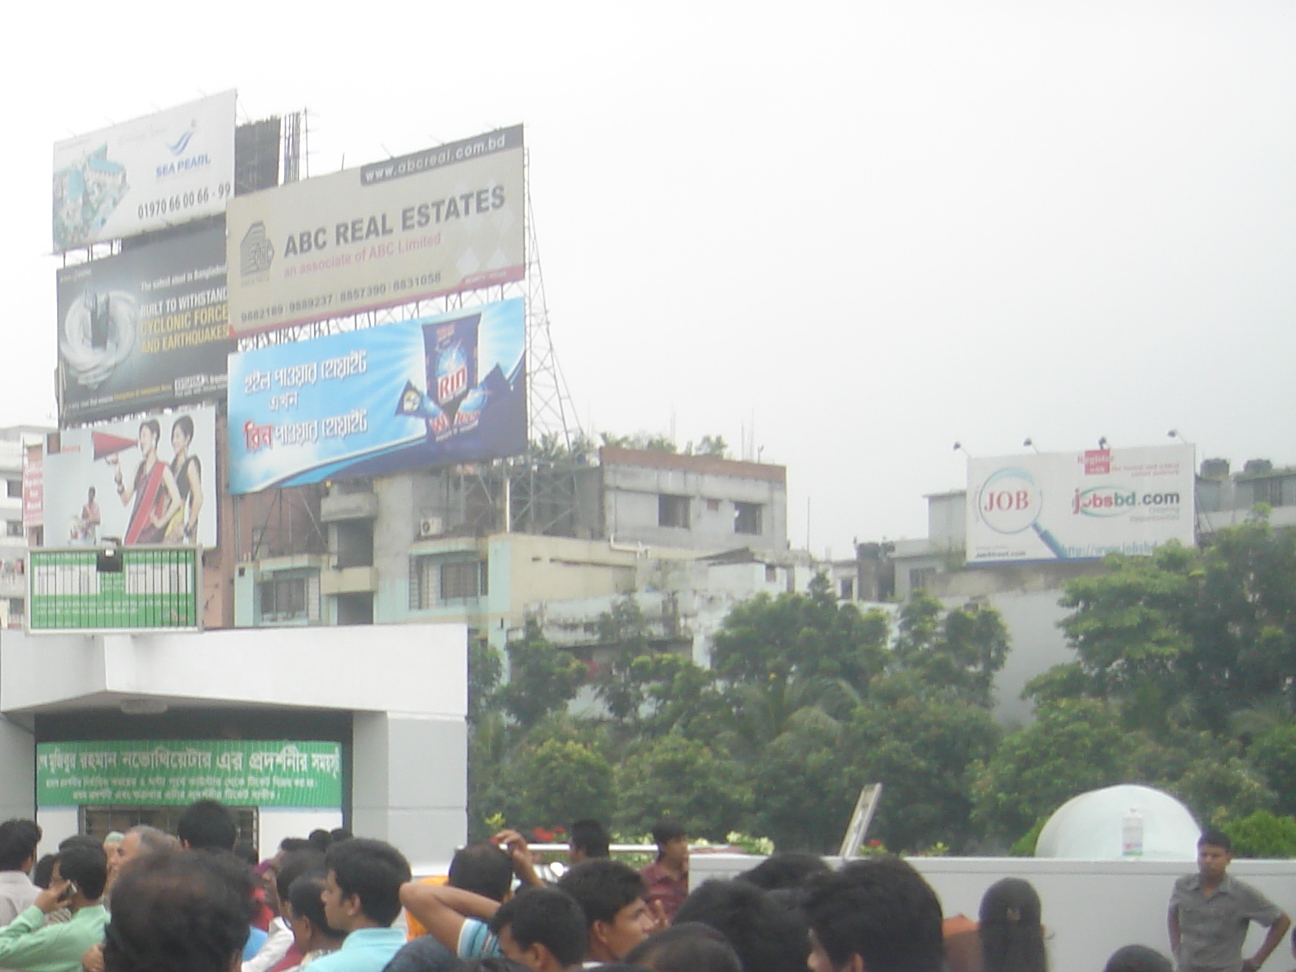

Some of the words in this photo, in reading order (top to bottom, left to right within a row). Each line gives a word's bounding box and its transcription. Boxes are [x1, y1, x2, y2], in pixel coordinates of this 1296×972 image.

[156, 164, 175, 178] SEA
[177, 153, 211, 171] PEARL
[365, 134, 505, 181] www.abcreal.com.bd
[138, 198, 166, 220] 01970
[169, 195, 180, 212] 66
[183, 192, 195, 209] 00
[197, 187, 209, 204] 66
[218, 183, 231, 199] 99
[284, 228, 327, 258] ABC
[336, 213, 394, 246] REAL
[402, 186, 506, 231] ESTATES
[284, 265, 296, 278] an
[299, 253, 351, 275] associate
[355, 248, 366, 263] of
[369, 242, 394, 260] ABC
[398, 231, 442, 254] Limited
[140, 300, 163, 317] BUILT
[166, 298, 177, 313] TO
[141, 312, 191, 337] CYCLONIC
[141, 338, 160, 353] AND
[274, 362, 317, 388] পাওয়ার
[321, 350, 367, 380] হোয়াইট
[269, 391, 299, 411] এখন
[244, 420, 273, 451] রিন
[275, 420, 318, 445] পাওয়ার
[322, 408, 368, 439] হোয়াইট
[985, 490, 1029, 512] JOB
[1072, 488, 1180, 515] jobsbd.com
[80, 751, 117, 771] রহমান
[216, 752, 243, 772] এর
[249, 745, 308, 773] প্রদর্শনীর
